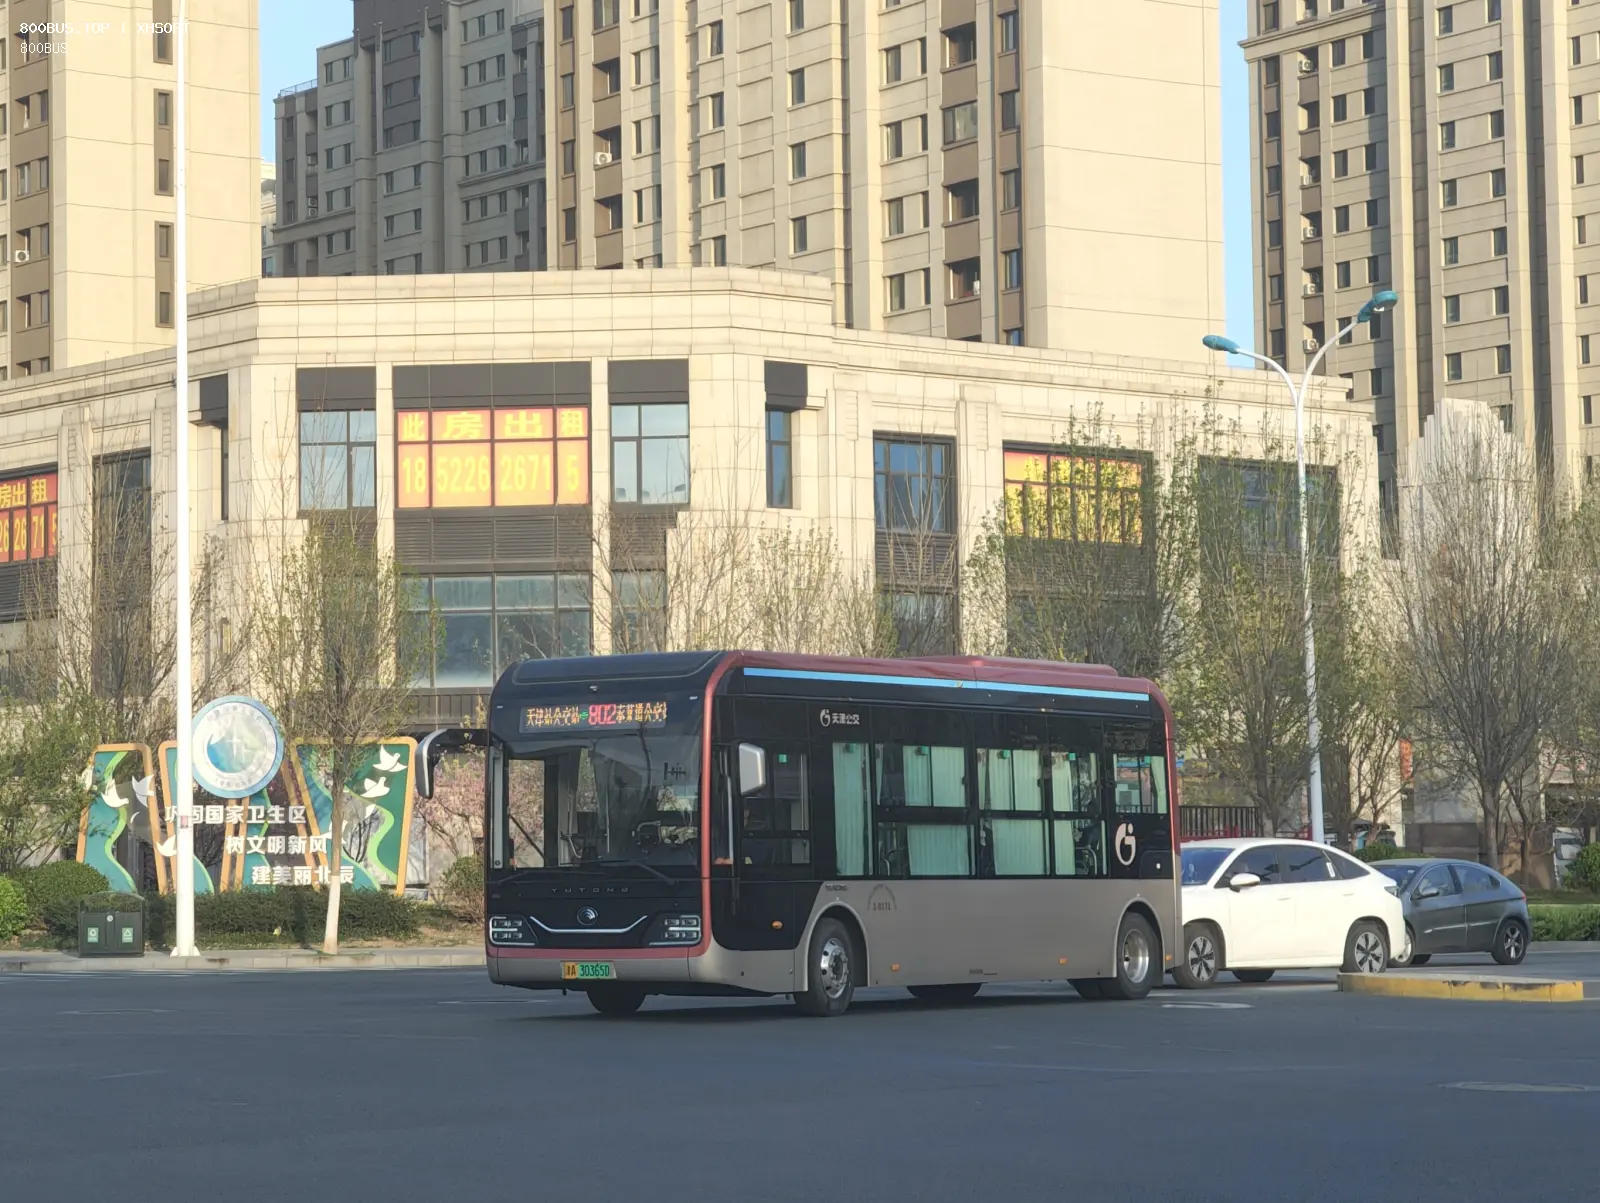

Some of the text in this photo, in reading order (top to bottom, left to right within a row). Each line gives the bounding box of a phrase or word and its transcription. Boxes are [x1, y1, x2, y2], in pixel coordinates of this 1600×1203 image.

[402, 410, 584, 440] 此房出租
[588, 704, 616, 725] 802
[832, 712, 860, 725] 天津公交
[225, 835, 327, 854] 树文明新风
[252, 865, 354, 885] 建美丽北辰
